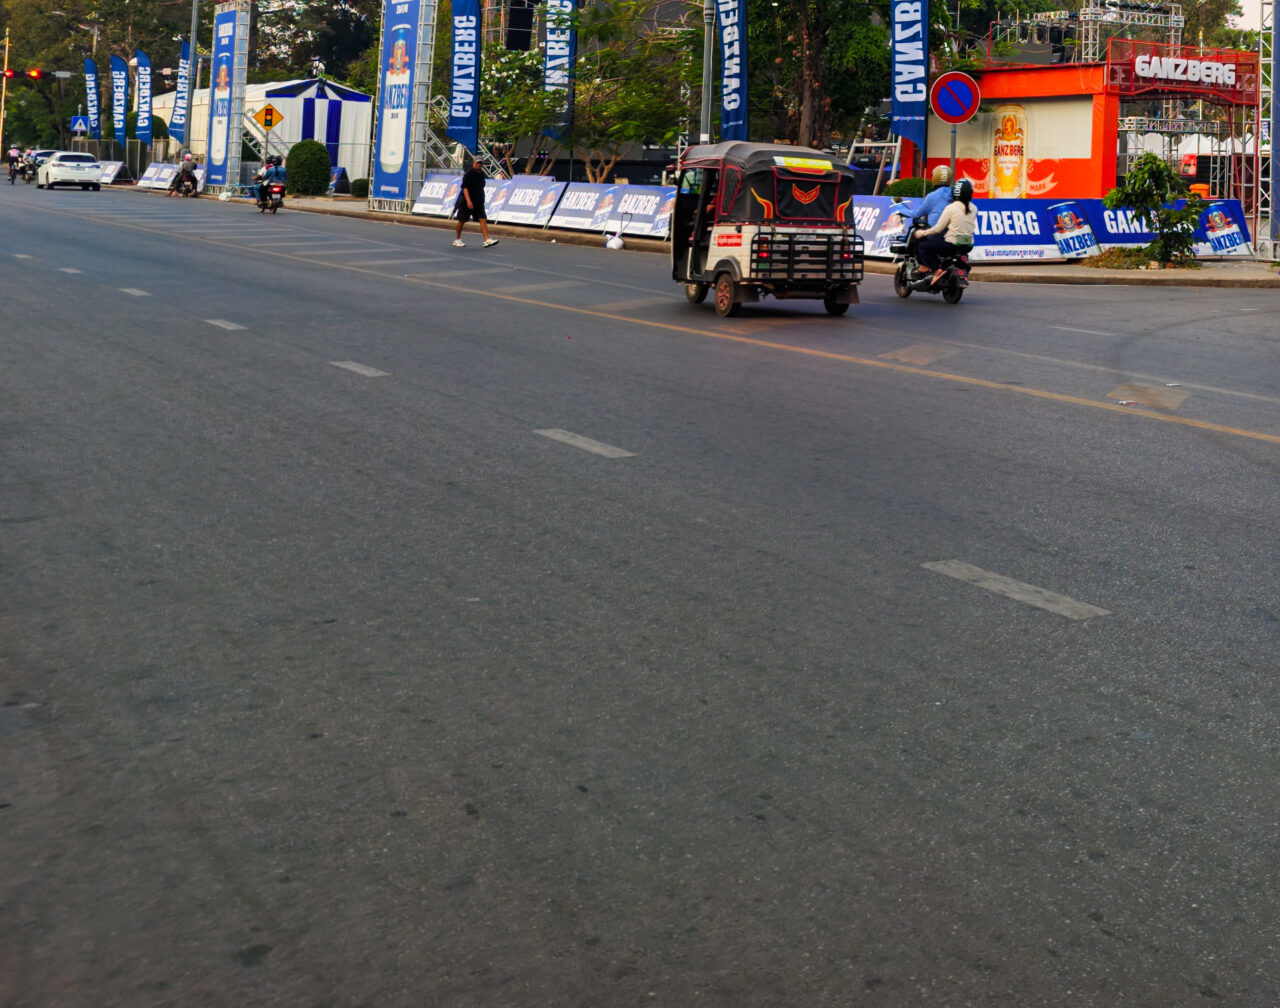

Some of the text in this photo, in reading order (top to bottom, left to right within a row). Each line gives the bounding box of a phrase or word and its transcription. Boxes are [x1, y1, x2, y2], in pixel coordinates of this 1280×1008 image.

[1135, 54, 1236, 85] GANZBERG
[854, 207, 880, 231] BERG
[975, 211, 1040, 235] ZBERG
